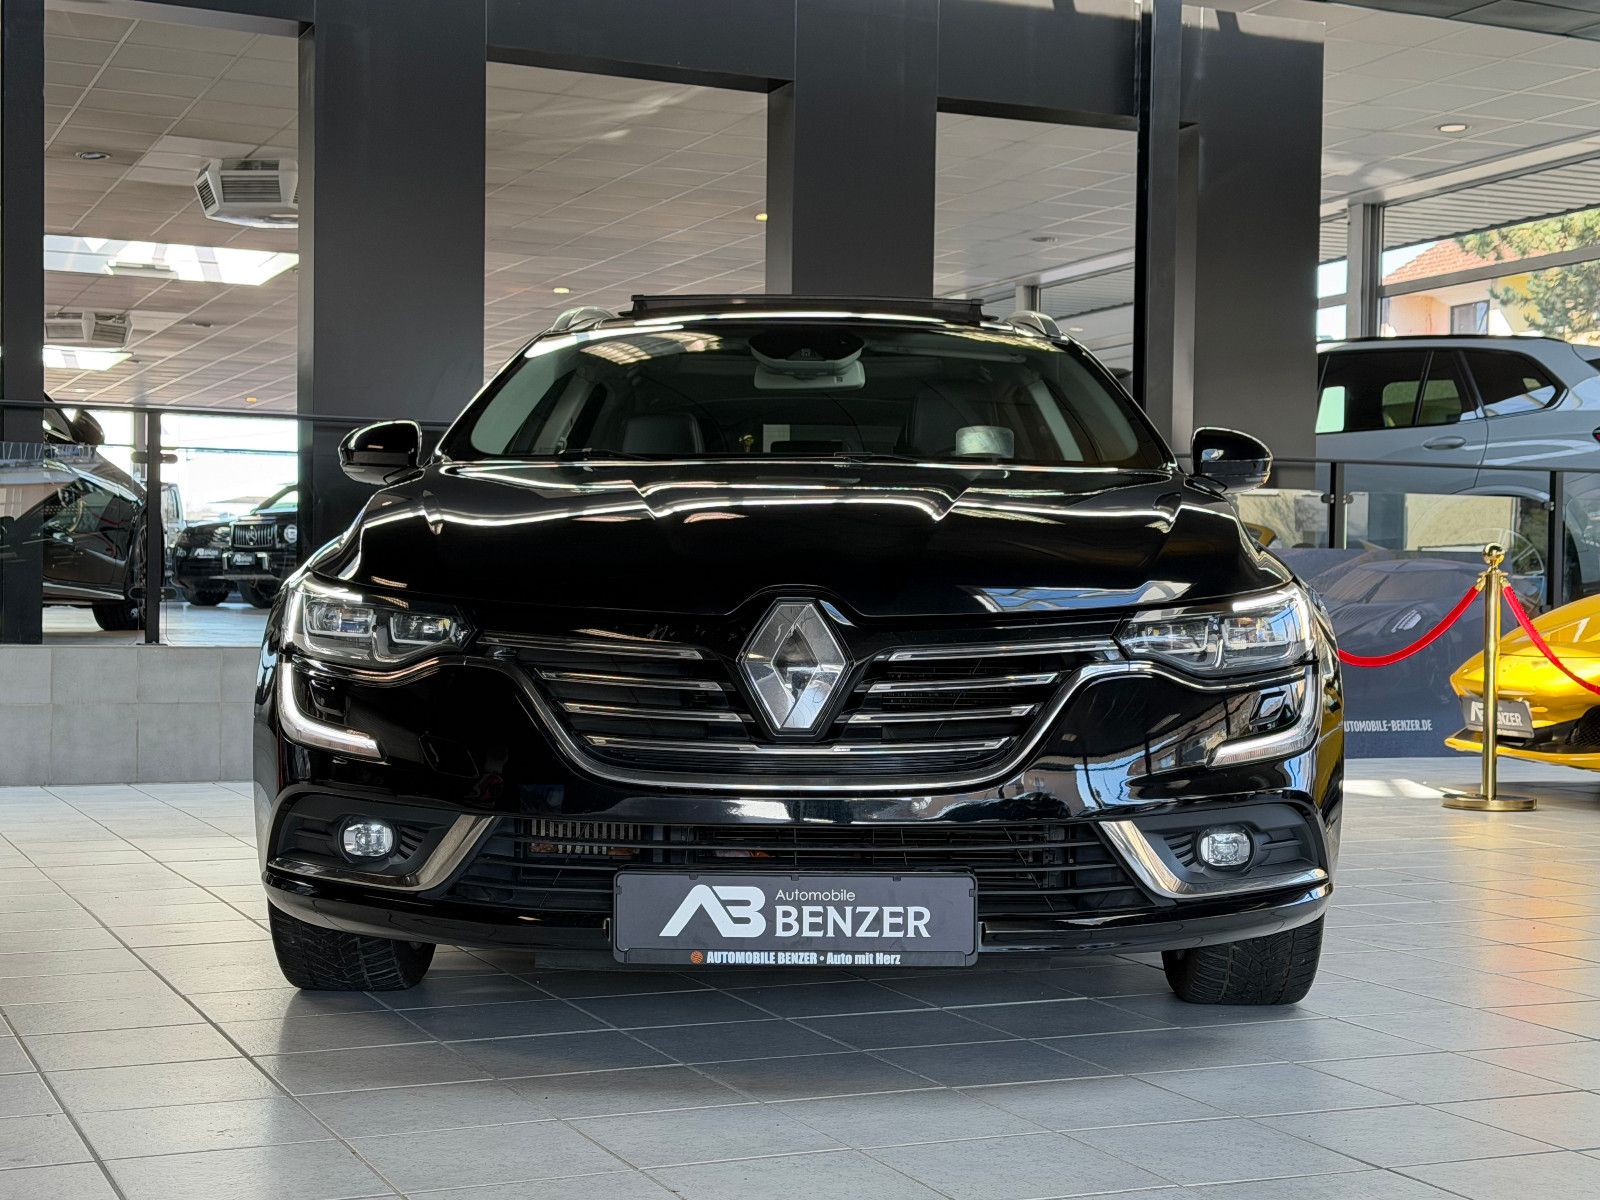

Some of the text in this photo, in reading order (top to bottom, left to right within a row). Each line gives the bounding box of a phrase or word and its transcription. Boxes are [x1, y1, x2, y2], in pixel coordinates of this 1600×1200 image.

[774, 888, 856, 902] Automobile
[774, 905, 931, 938] BENZER
[706, 951, 901, 965] AUTOMOBILE BENZER Auto mit Herz
